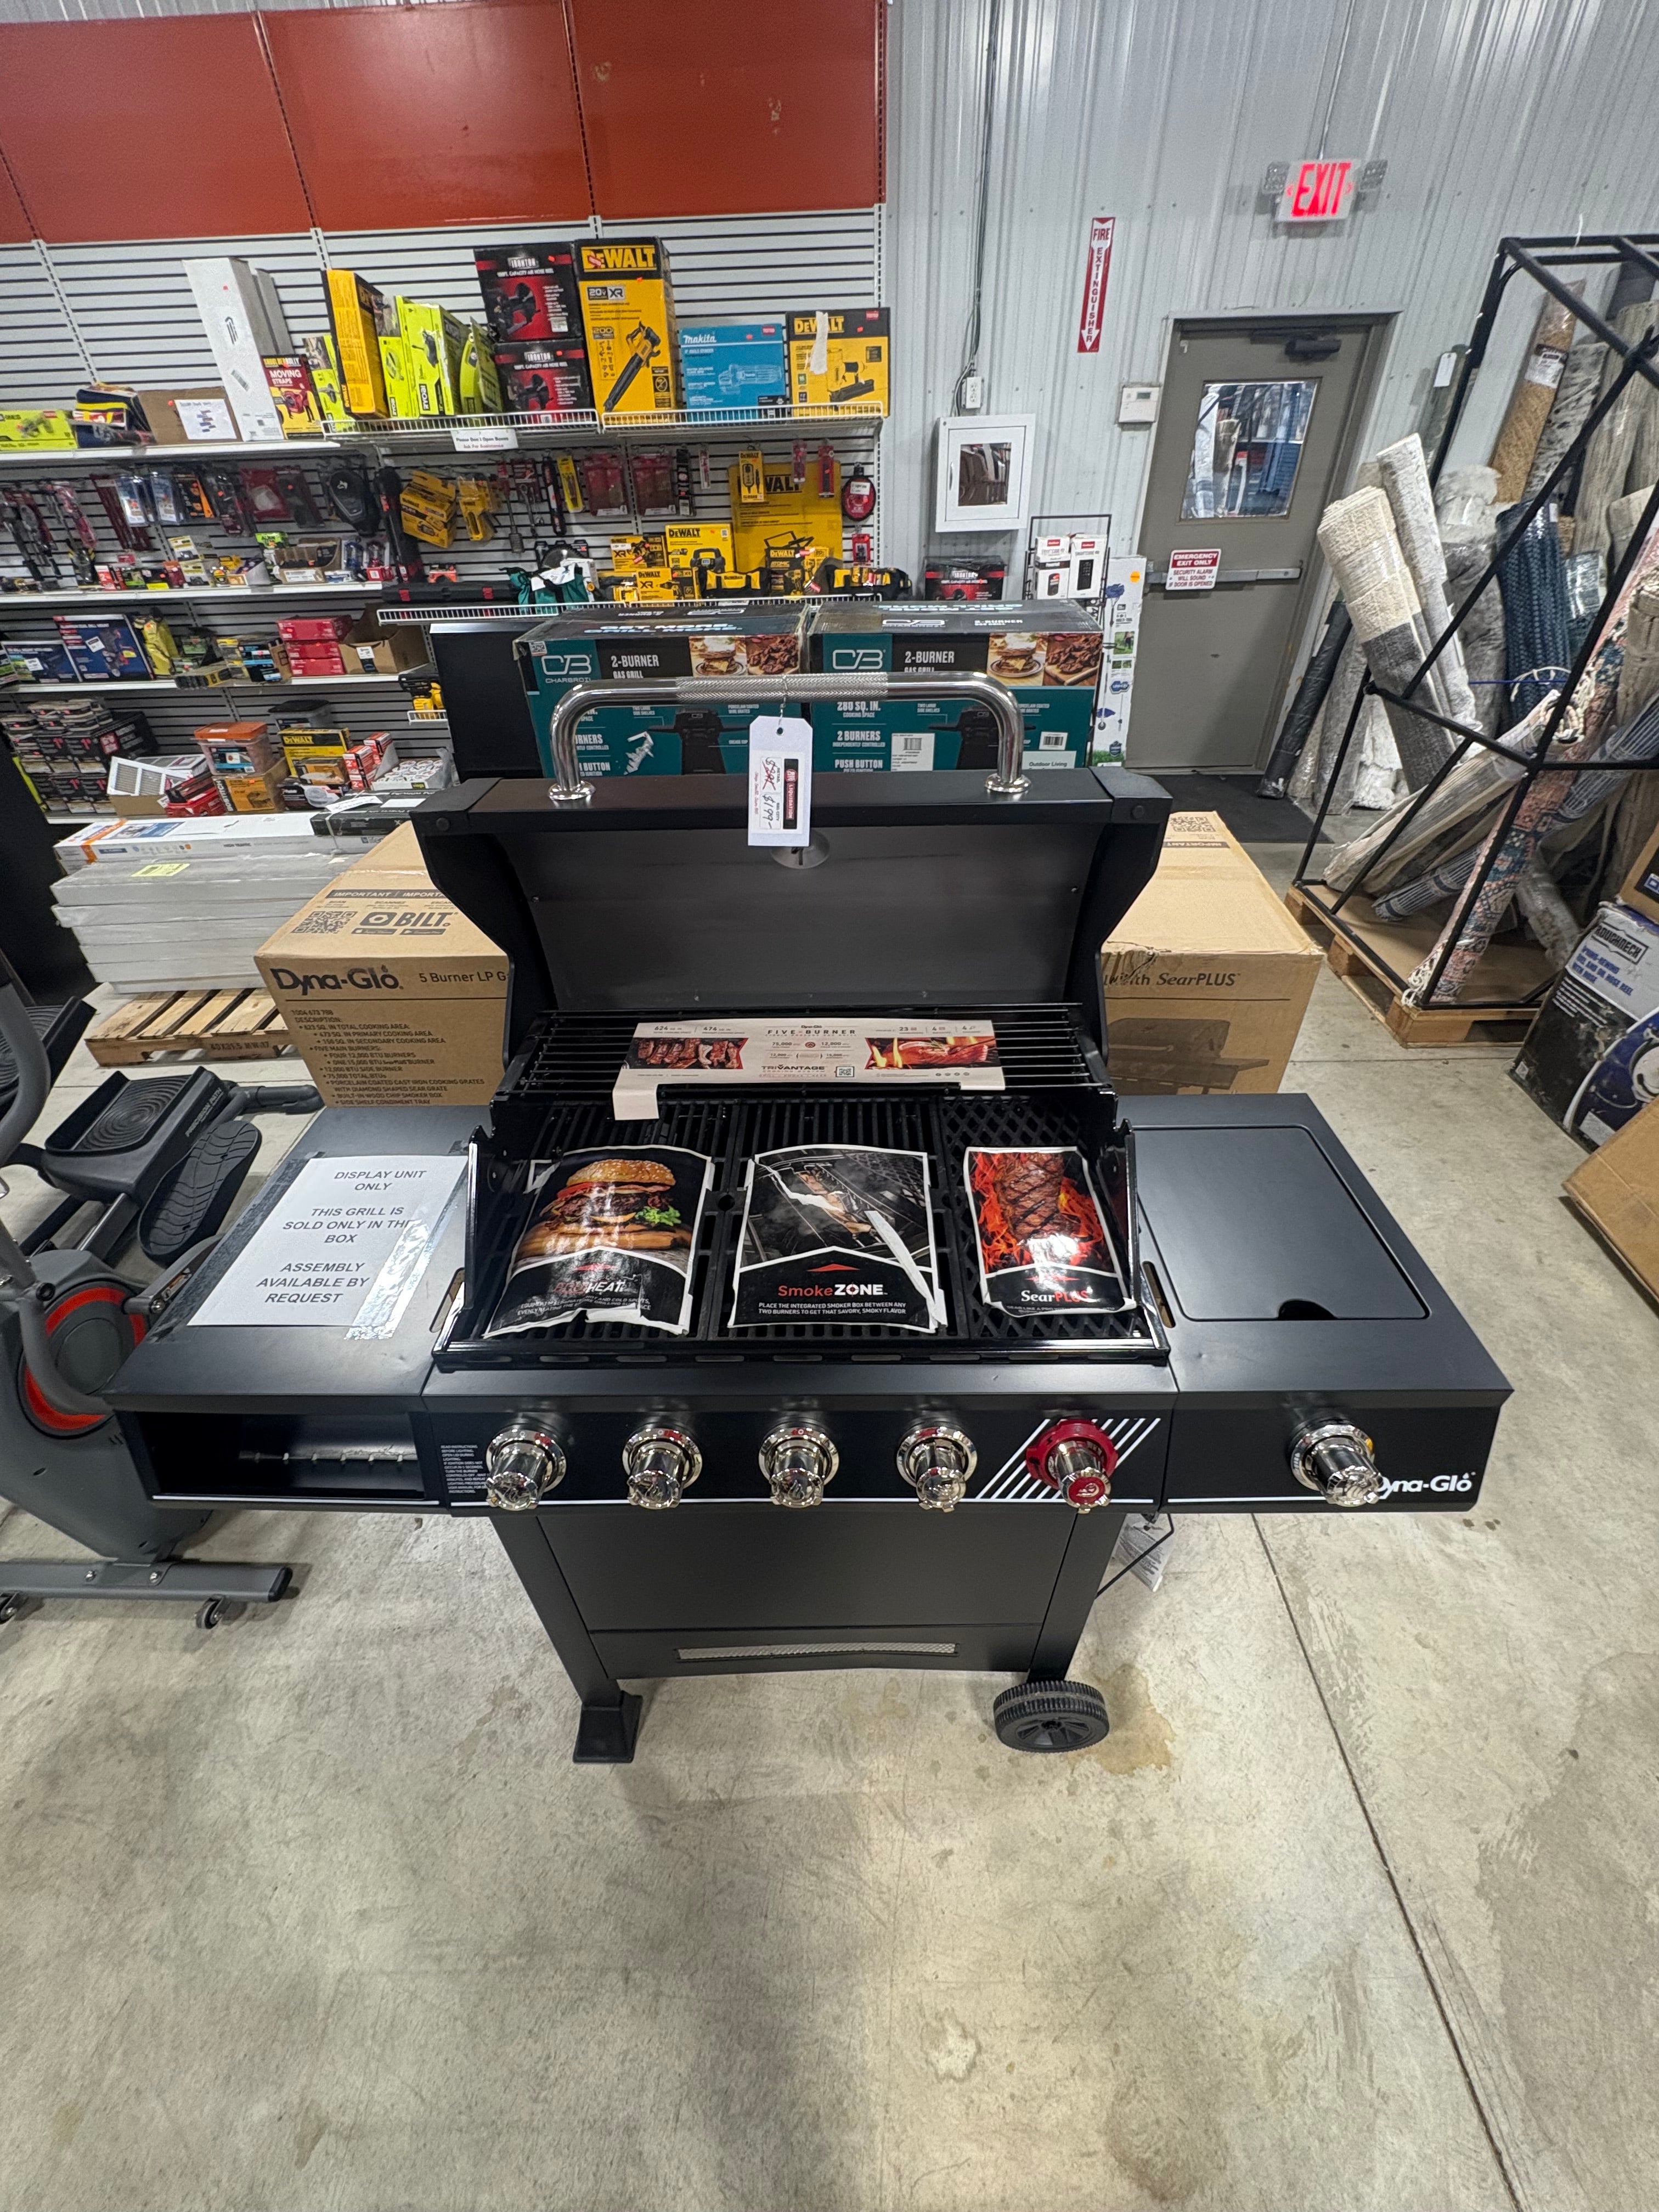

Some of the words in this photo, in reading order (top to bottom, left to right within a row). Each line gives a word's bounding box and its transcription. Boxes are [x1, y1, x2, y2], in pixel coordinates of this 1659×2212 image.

[1291, 162, 1352, 217] EXIT
[1093, 228, 1110, 241] FIRE
[511, 258, 537, 268] IRONTON
[582, 248, 656, 269] DEWALT
[609, 288, 623, 297] XR
[1086, 247, 1103, 343] EXTINGUISHER
[527, 352, 551, 362] IRONTON
[269, 369, 302, 378] MOVING
[419, 384, 430, 410] RYOBI
[669, 528, 701, 538] DEWALT
[611, 654, 659, 668] 2-BURNER
[905, 651, 955, 664] 2-BURNER
[837, 702, 854, 711] 280
[855, 702, 868, 713] SQ.
[870, 701, 881, 711] IN.
[283, 735, 313, 744] DEWALT
[837, 731, 843, 741] 2
[844, 731, 881, 741] BURNERS
[584, 763, 611, 771] BUTTON
[834, 759, 854, 769] PUSH
[855, 759, 883, 769] BUTTON
[393, 912, 454, 927] BILT
[1594, 924, 1643, 959] ROUGHNECK
[270, 964, 400, 996] Dyna-Glo
[419, 972, 427, 983] 5
[431, 972, 475, 983] Burner
[477, 972, 494, 982] LP
[1156, 973, 1236, 986] SearPLUS
[334, 1171, 392, 1180] DISPLAY
[394, 1170, 427, 1178] UNIT
[311, 1208, 342, 1216] THIS
[345, 1207, 386, 1216] GRILL
[390, 1207, 404, 1215] IS
[283, 1221, 323, 1230] SOLD
[326, 1221, 366, 1229] ONLY
[367, 1220, 383, 1229] IN
[324, 1234, 358, 1243] BOX
[279, 1263, 366, 1272] ASSEMBLY
[256, 1277, 346, 1288] AVAILABLE
[346, 1277, 371, 1287] BY
[264, 1293, 344, 1304] REQUEST
